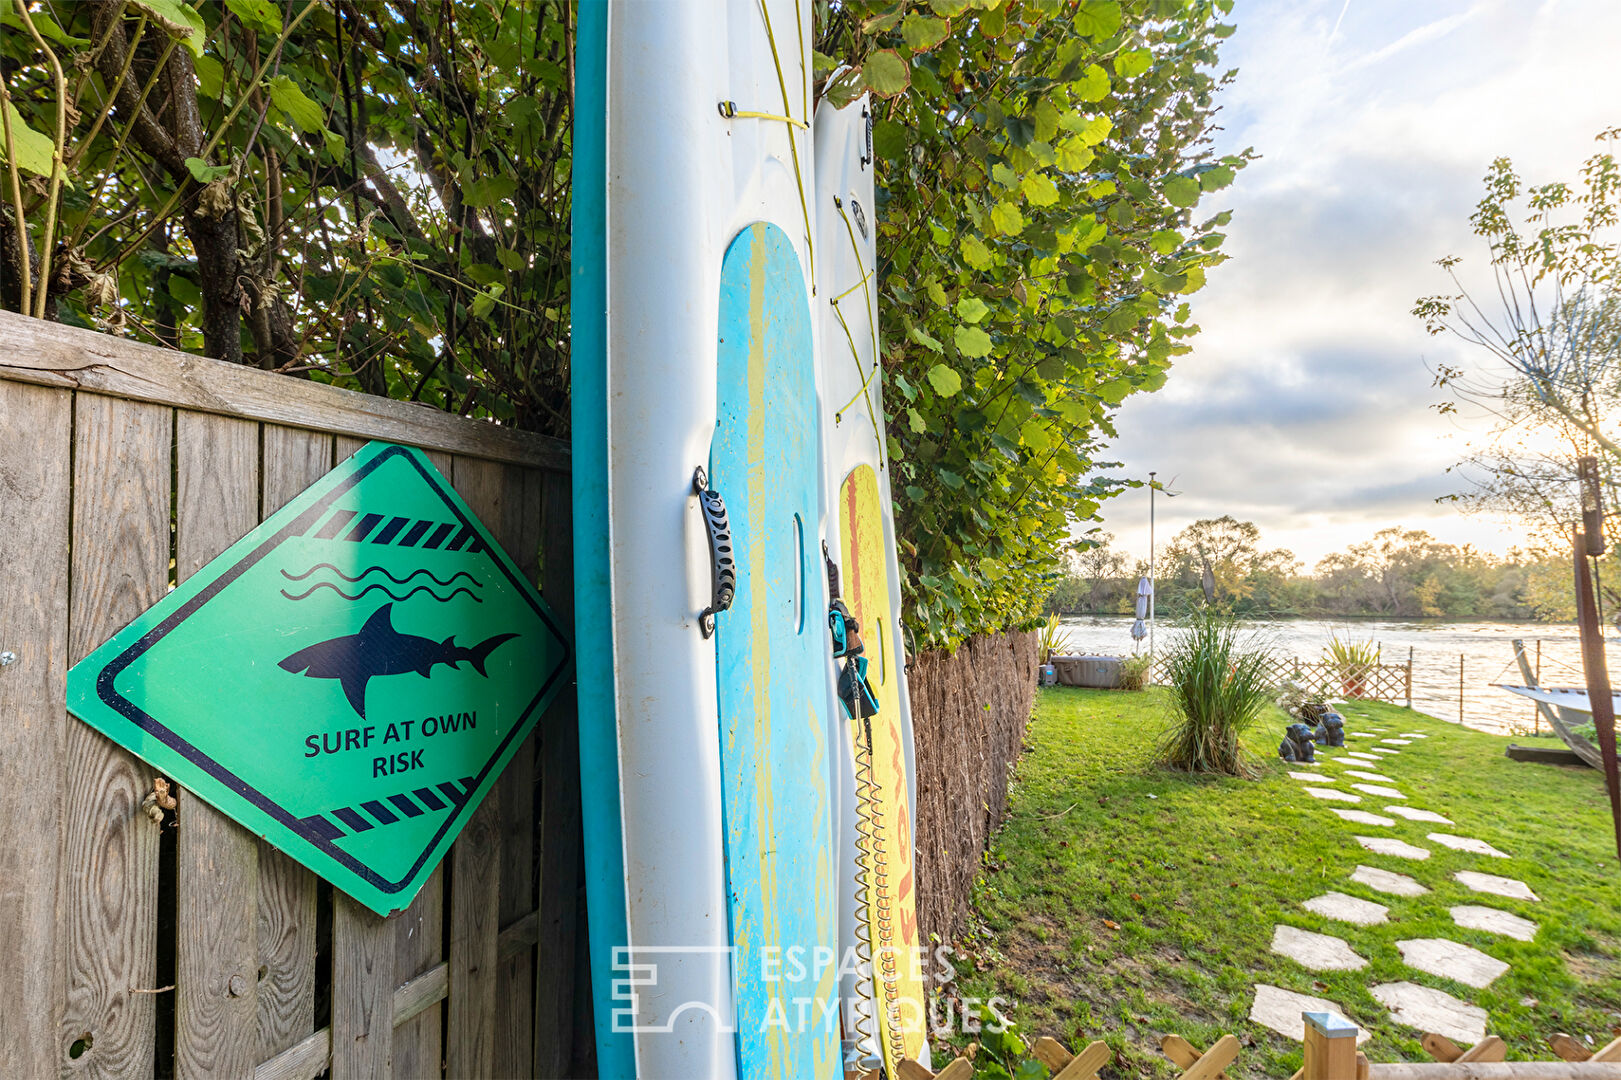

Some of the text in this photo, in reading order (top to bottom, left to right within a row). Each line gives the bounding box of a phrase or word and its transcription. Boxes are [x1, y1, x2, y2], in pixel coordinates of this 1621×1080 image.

[304, 711, 477, 758] SURF AT OWN
[372, 748, 425, 778] RISK
